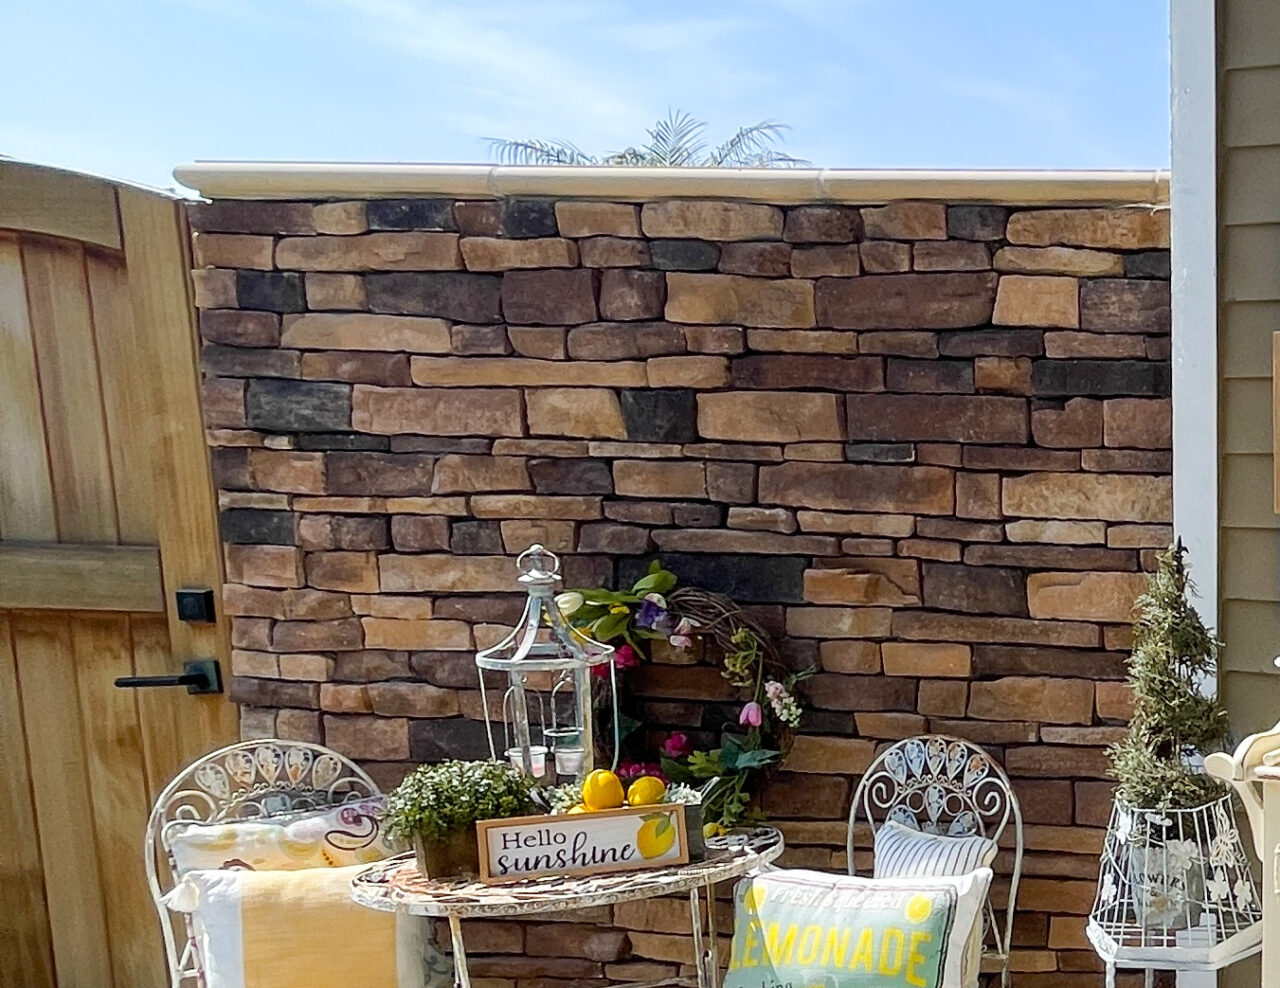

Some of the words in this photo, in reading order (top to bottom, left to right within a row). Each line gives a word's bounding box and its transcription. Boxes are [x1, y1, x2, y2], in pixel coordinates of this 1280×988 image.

[498, 830, 636, 876] sunshine
[501, 828, 567, 850] Hello
[730, 919, 933, 988] LEMONADE
